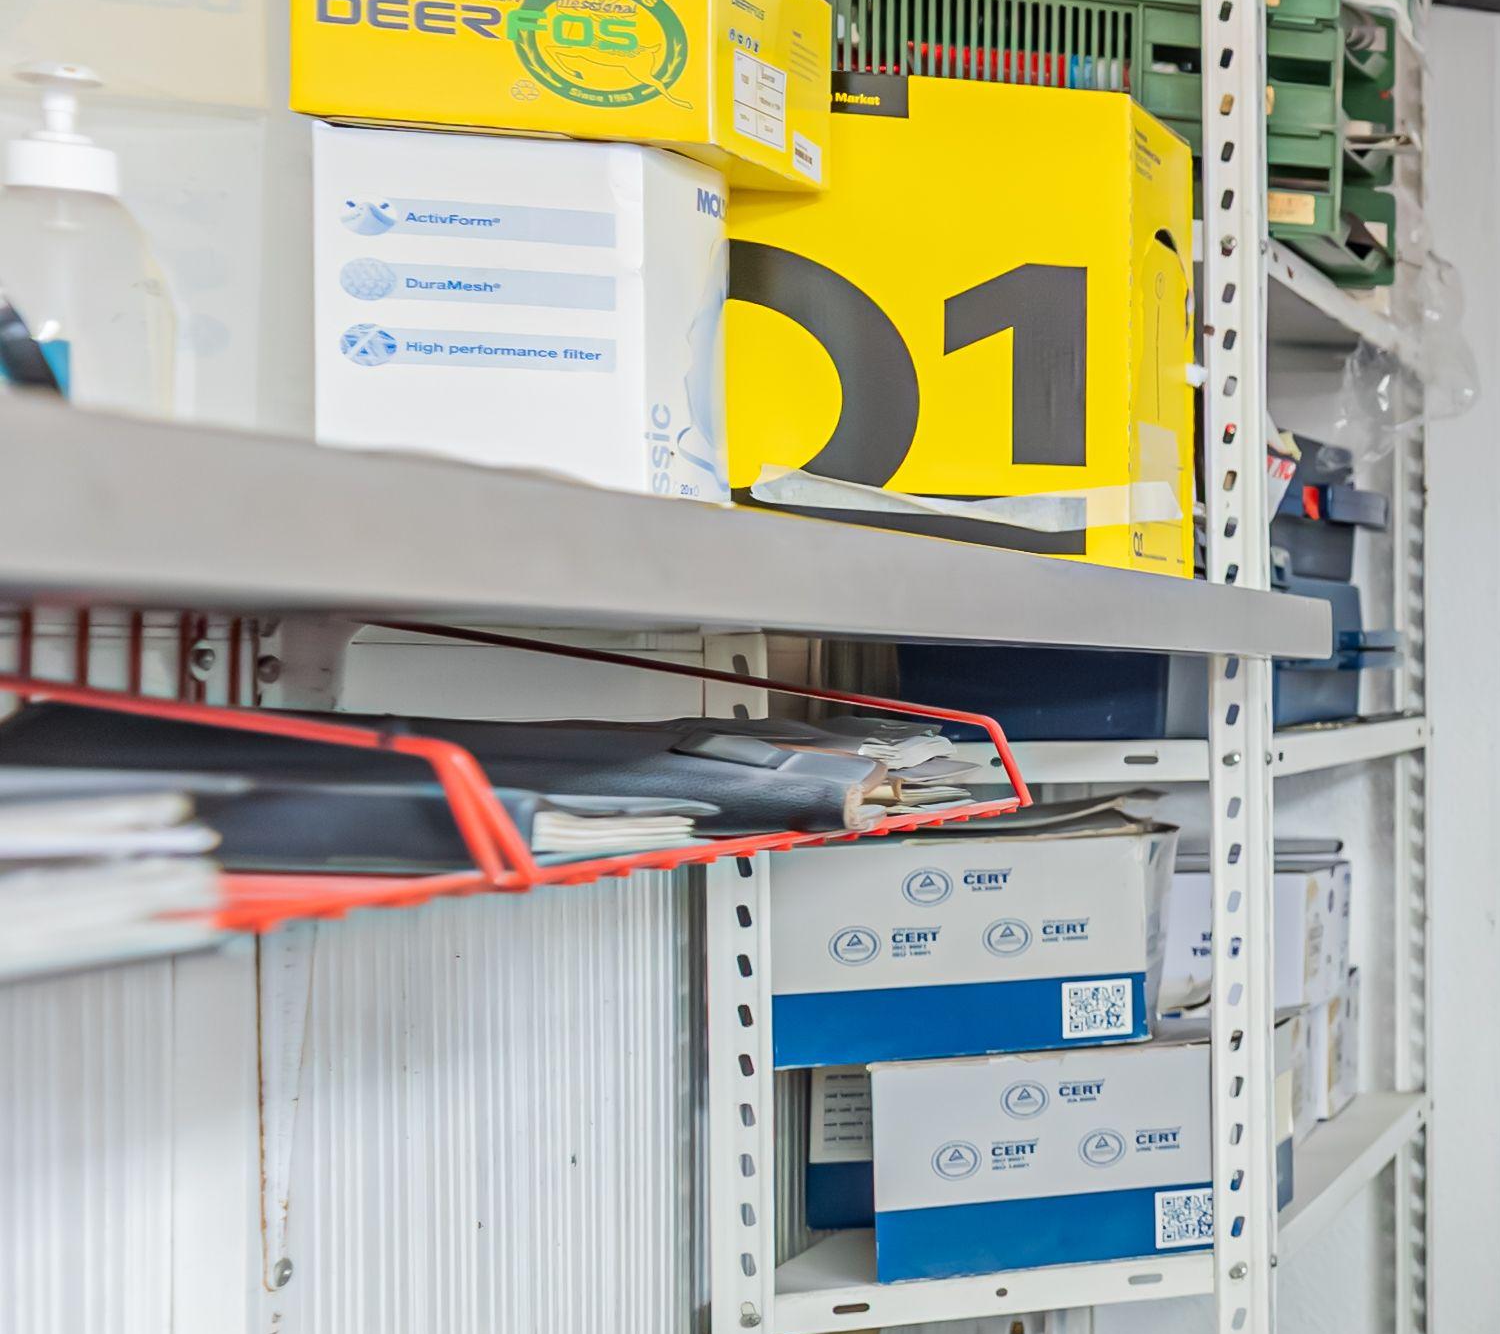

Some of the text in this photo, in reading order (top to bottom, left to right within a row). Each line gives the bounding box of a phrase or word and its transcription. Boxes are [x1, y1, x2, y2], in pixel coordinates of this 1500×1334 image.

[835, 92, 881, 107] Market
[405, 341, 602, 362] High performance filter
